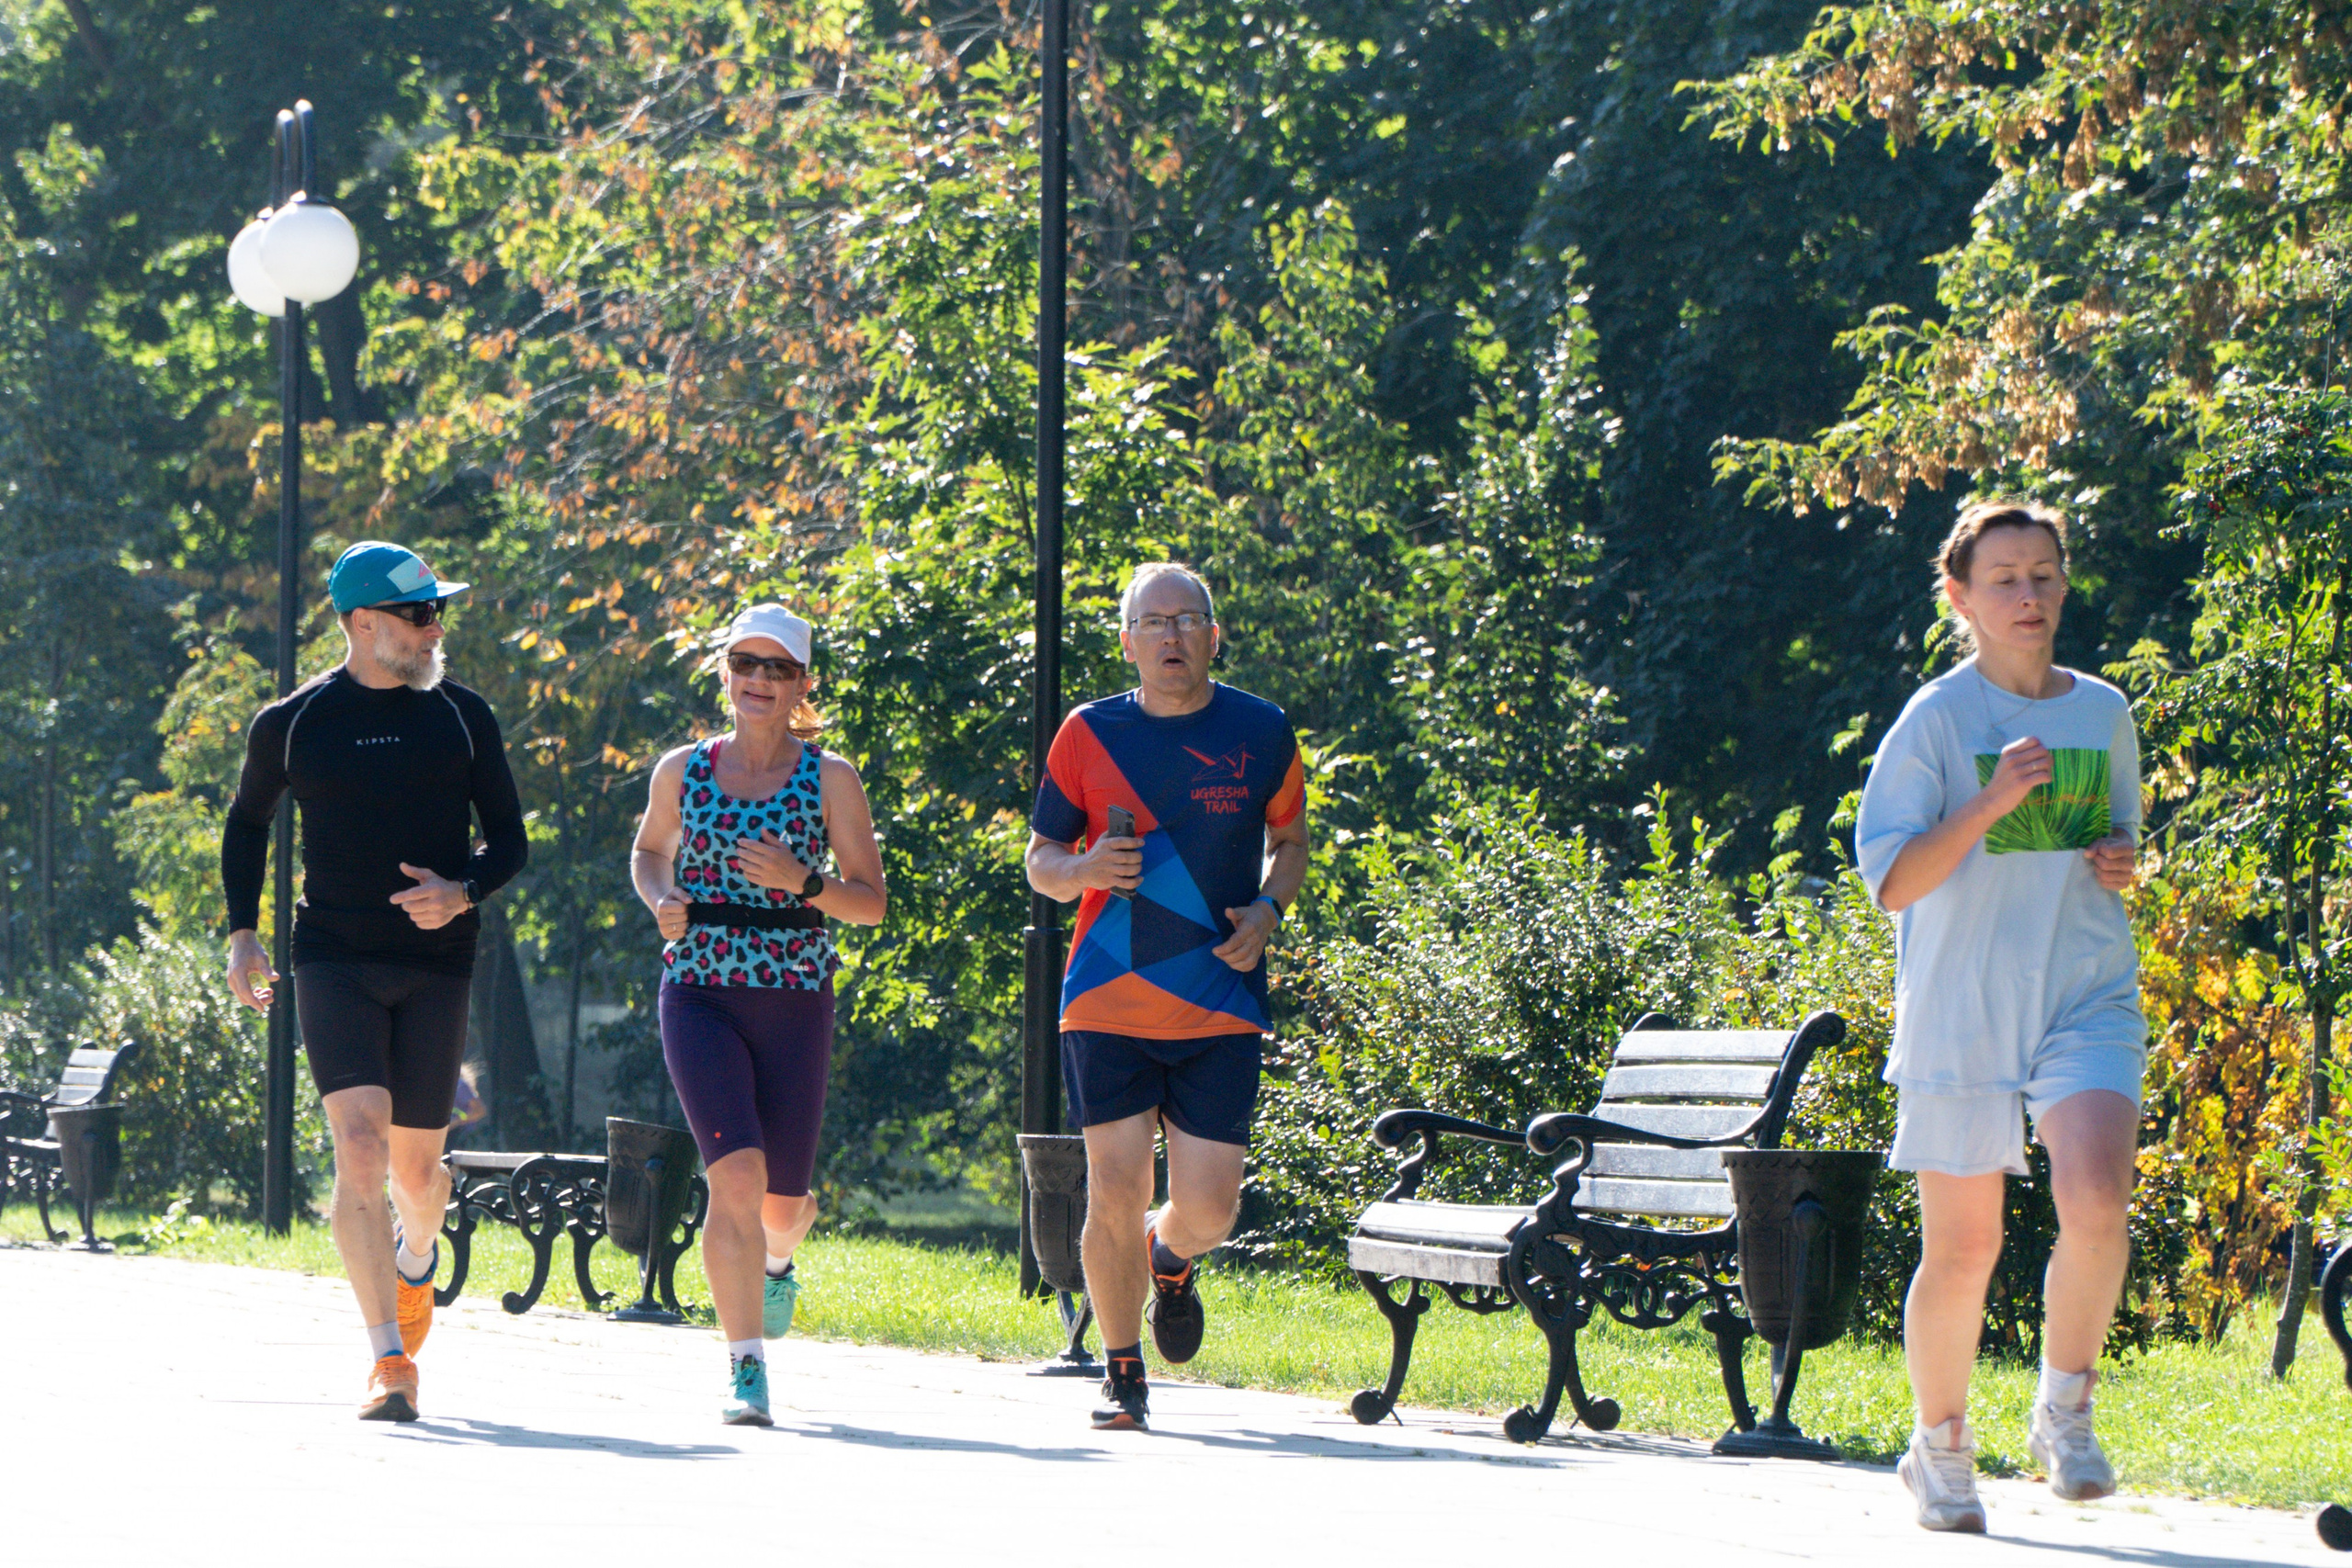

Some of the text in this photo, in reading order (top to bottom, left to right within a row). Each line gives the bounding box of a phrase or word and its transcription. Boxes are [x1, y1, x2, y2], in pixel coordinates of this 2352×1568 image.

[356, 736, 401, 745] KIPSTA
[1190, 785, 1249, 800] UGRESHA
[1204, 800, 1242, 815] TRAIL
